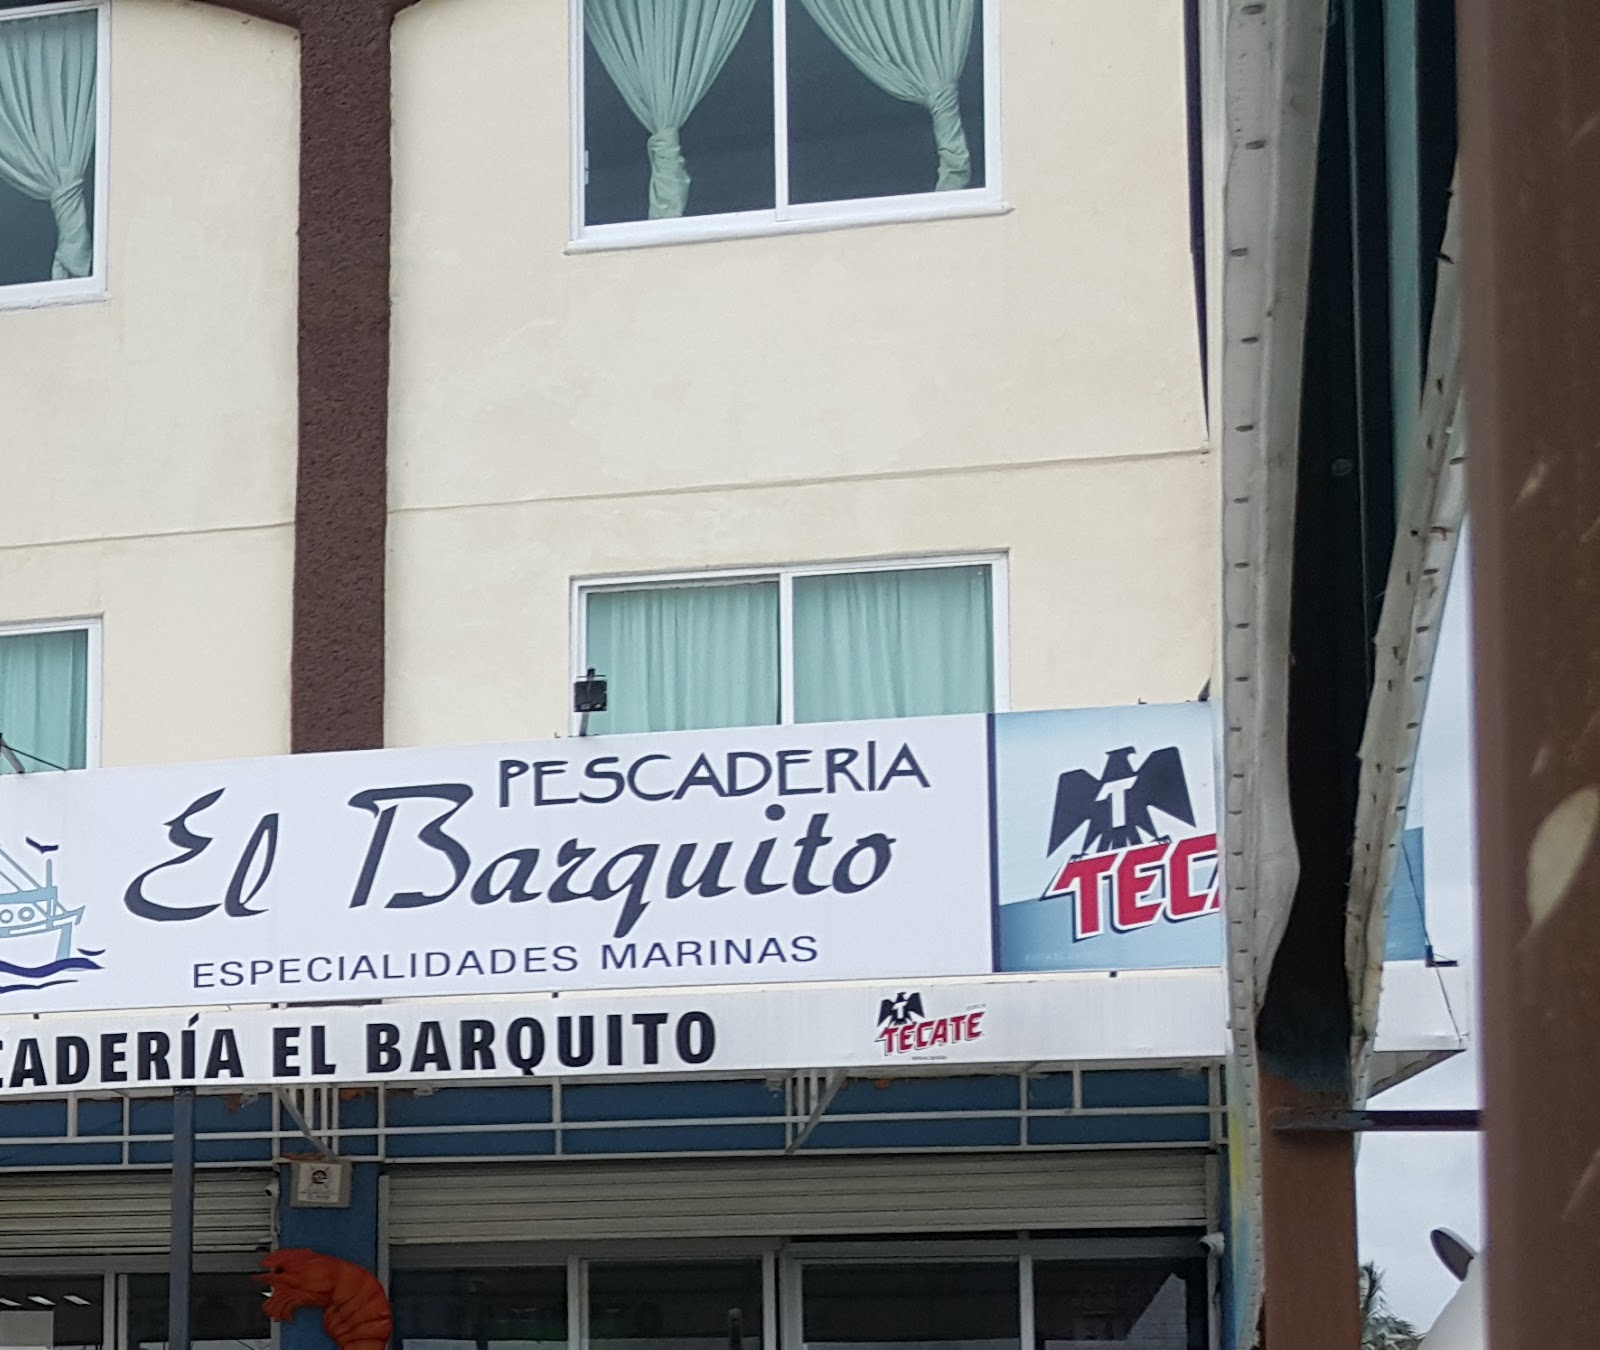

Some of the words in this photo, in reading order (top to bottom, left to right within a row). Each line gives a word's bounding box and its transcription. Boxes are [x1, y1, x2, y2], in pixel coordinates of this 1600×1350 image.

[124, 787, 279, 922] El
[349, 782, 896, 938] Barquito
[1041, 833, 1221, 942] TEC
[193, 945, 577, 990] ESPECIALIDADES
[600, 935, 819, 971] MARINAS
[274, 1024, 336, 1078] EL
[365, 1010, 716, 1076] BARQUITO
[875, 1012, 985, 1056] TECATE
